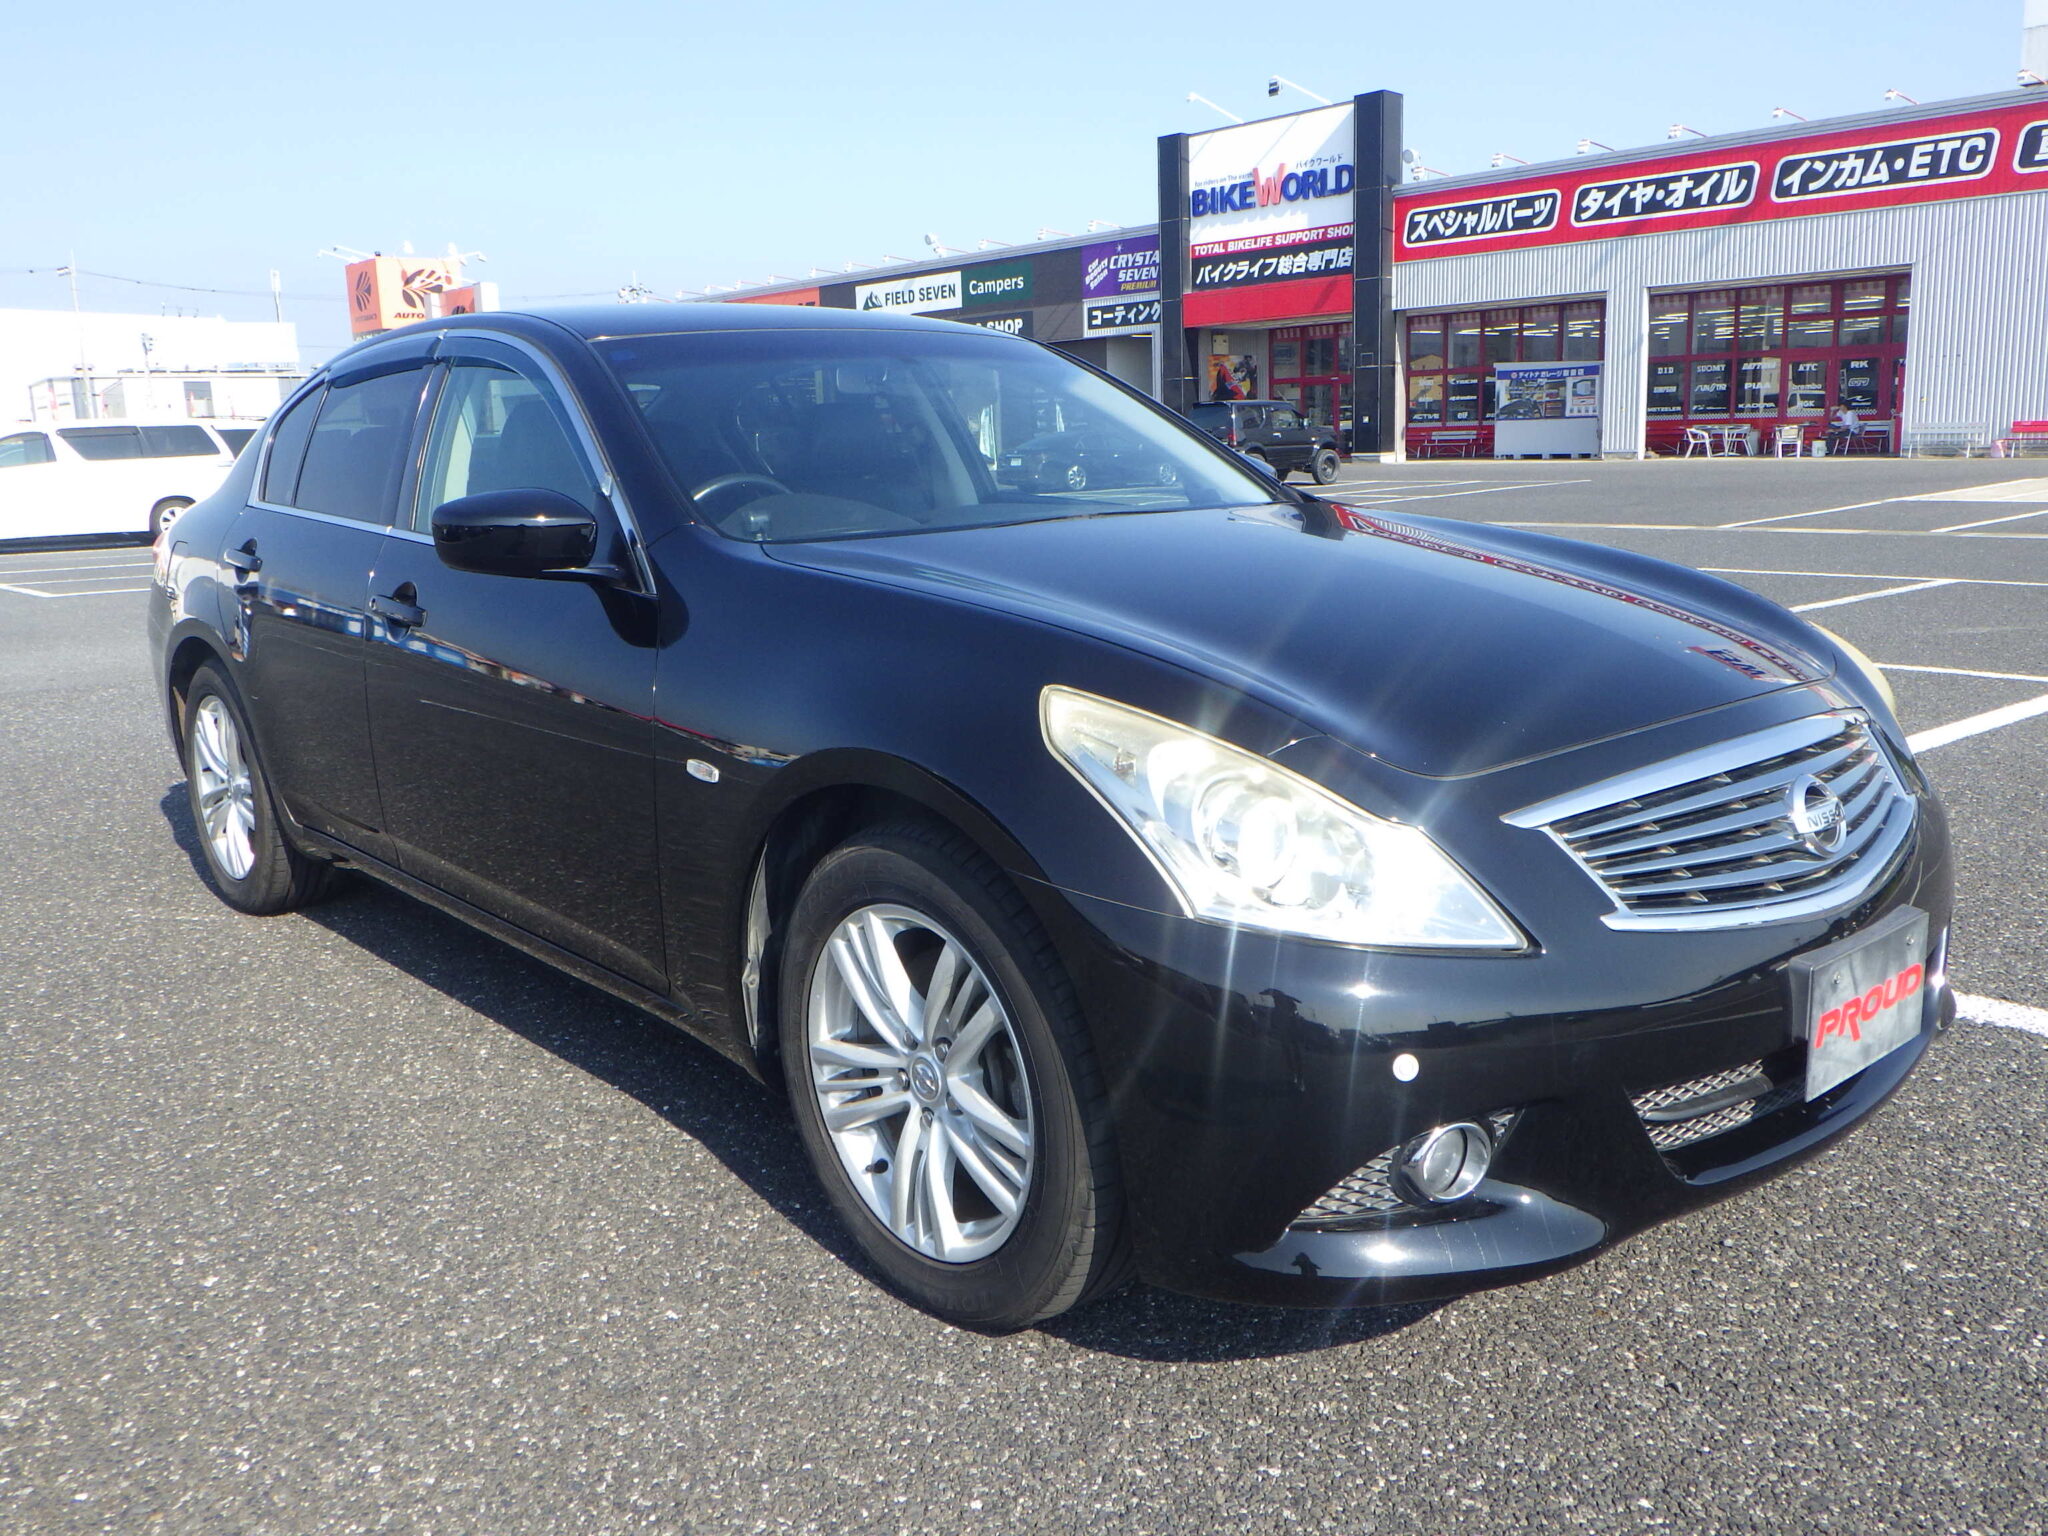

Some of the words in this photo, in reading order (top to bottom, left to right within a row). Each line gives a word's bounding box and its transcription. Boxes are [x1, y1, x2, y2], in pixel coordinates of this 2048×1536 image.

[1782, 136, 1987, 195] インカム・ETC
[1579, 168, 1748, 220] タイヤ・オイル
[1409, 197, 1553, 241] スペシャルパーツ
[1194, 243, 1225, 256] TOTAL
[1227, 236, 1273, 252] BIKELIFE
[1274, 229, 1325, 245] SUPPORT
[1109, 250, 1160, 270] CRYSTA
[1195, 246, 1354, 285] バイクライフ総合専門店
[969, 276, 1024, 295] Campers
[1118, 265, 1159, 282] SEVEN
[1121, 280, 1157, 292] PREMIUM
[885, 290, 915, 307] FIELD
[919, 283, 956, 302] SEVEN
[986, 318, 1023, 335] SHOP
[1850, 360, 1869, 369] RK
[1806, 802, 1843, 828] NISSA
[1813, 963, 1923, 1050] PROUD
